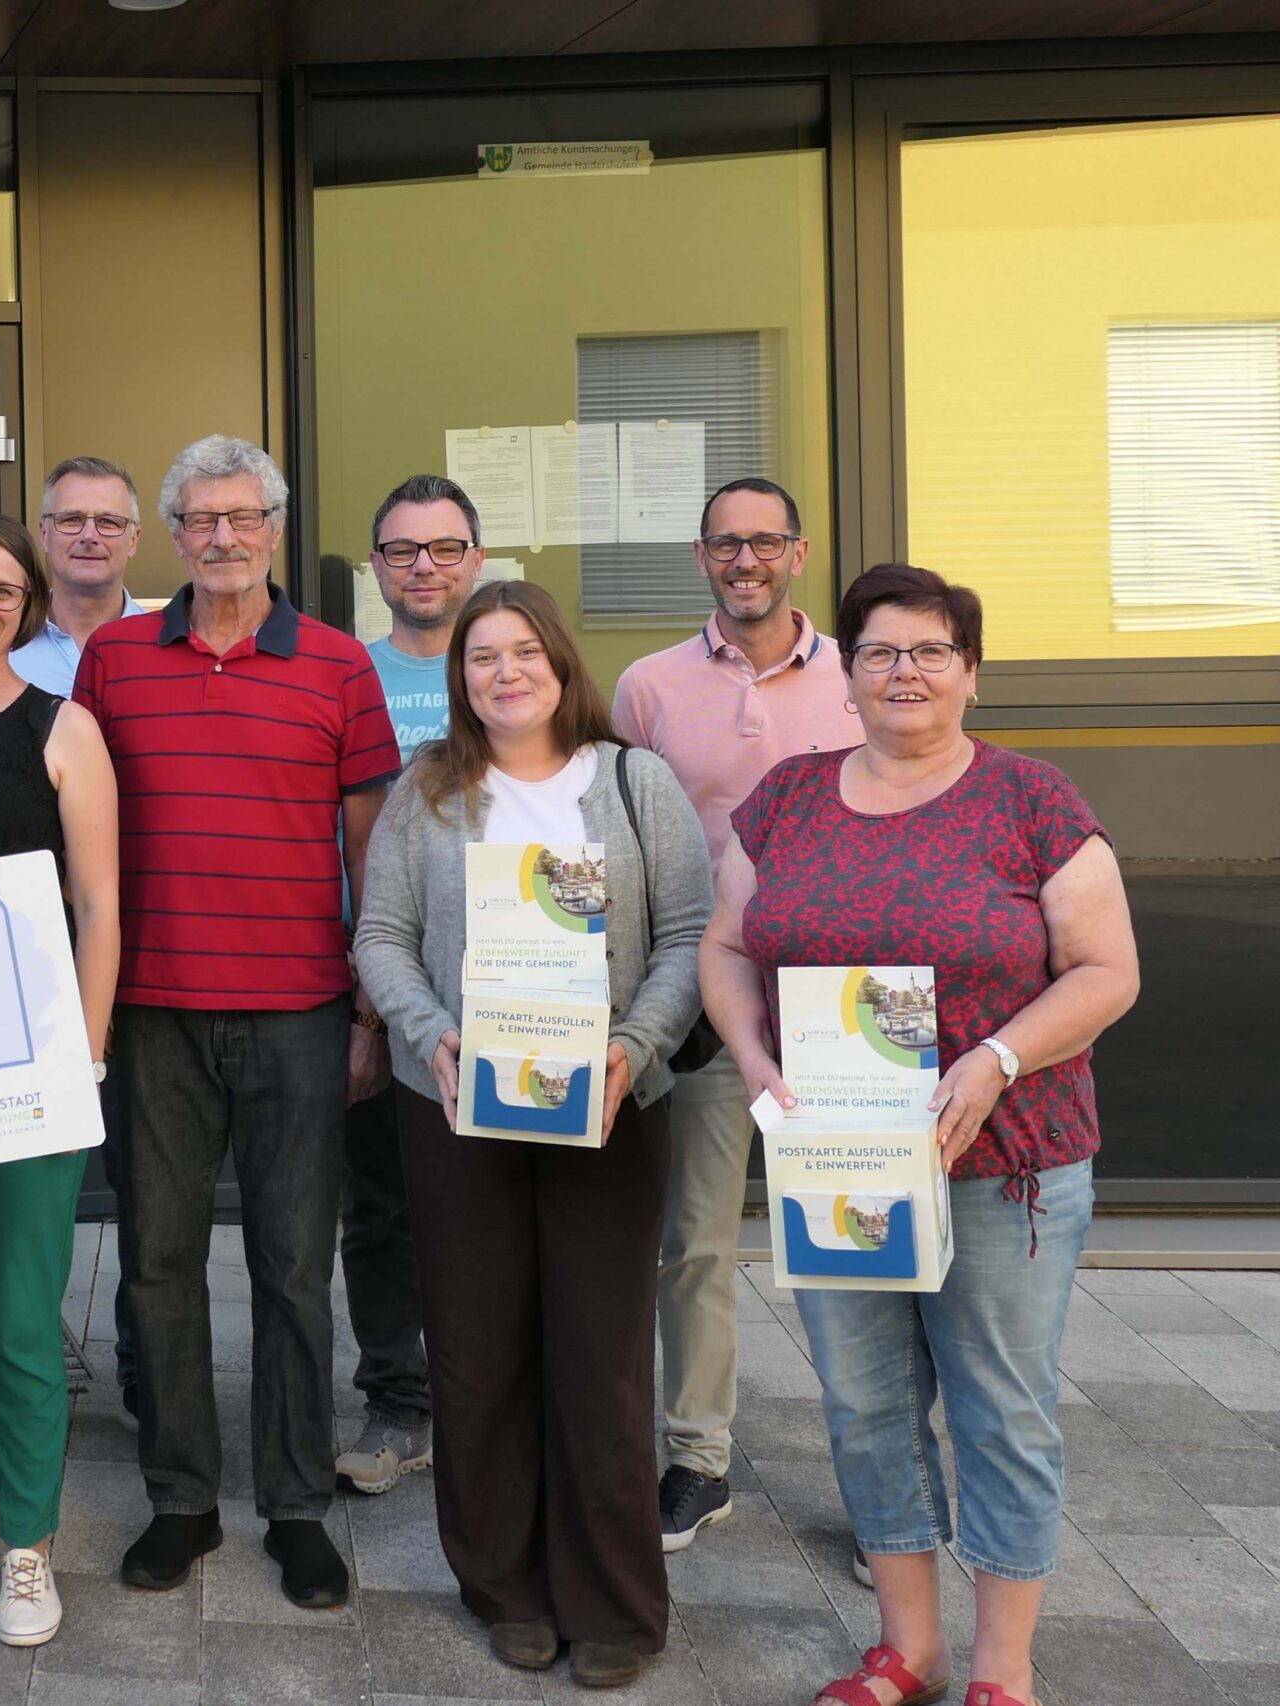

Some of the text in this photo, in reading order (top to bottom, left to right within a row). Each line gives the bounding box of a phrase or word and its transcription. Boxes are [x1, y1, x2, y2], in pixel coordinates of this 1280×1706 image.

[517, 143, 640, 155] Amtliche Kundmachungen
[524, 158, 639, 171] Gemeinde Haidershofen
[475, 948, 588, 958] LEBENSWERTE ZUKUNFT
[495, 959, 522, 967] DEINE
[525, 959, 578, 968] GEMEINDE!
[475, 1009, 595, 1028] POSTKARTE AUSFÜLLEN
[497, 1024, 570, 1038] & EINWERFEN!
[794, 1086, 920, 1097] LEBENSWERTE ZUKUNFT
[0, 1091, 42, 1110] STADT
[818, 1097, 848, 1107] DEINE
[851, 1098, 910, 1108] GEMEINDE!
[778, 1145, 913, 1157] POSTKARTE AUSFÜLLEN
[805, 1161, 887, 1171] & EINWERFEN!
